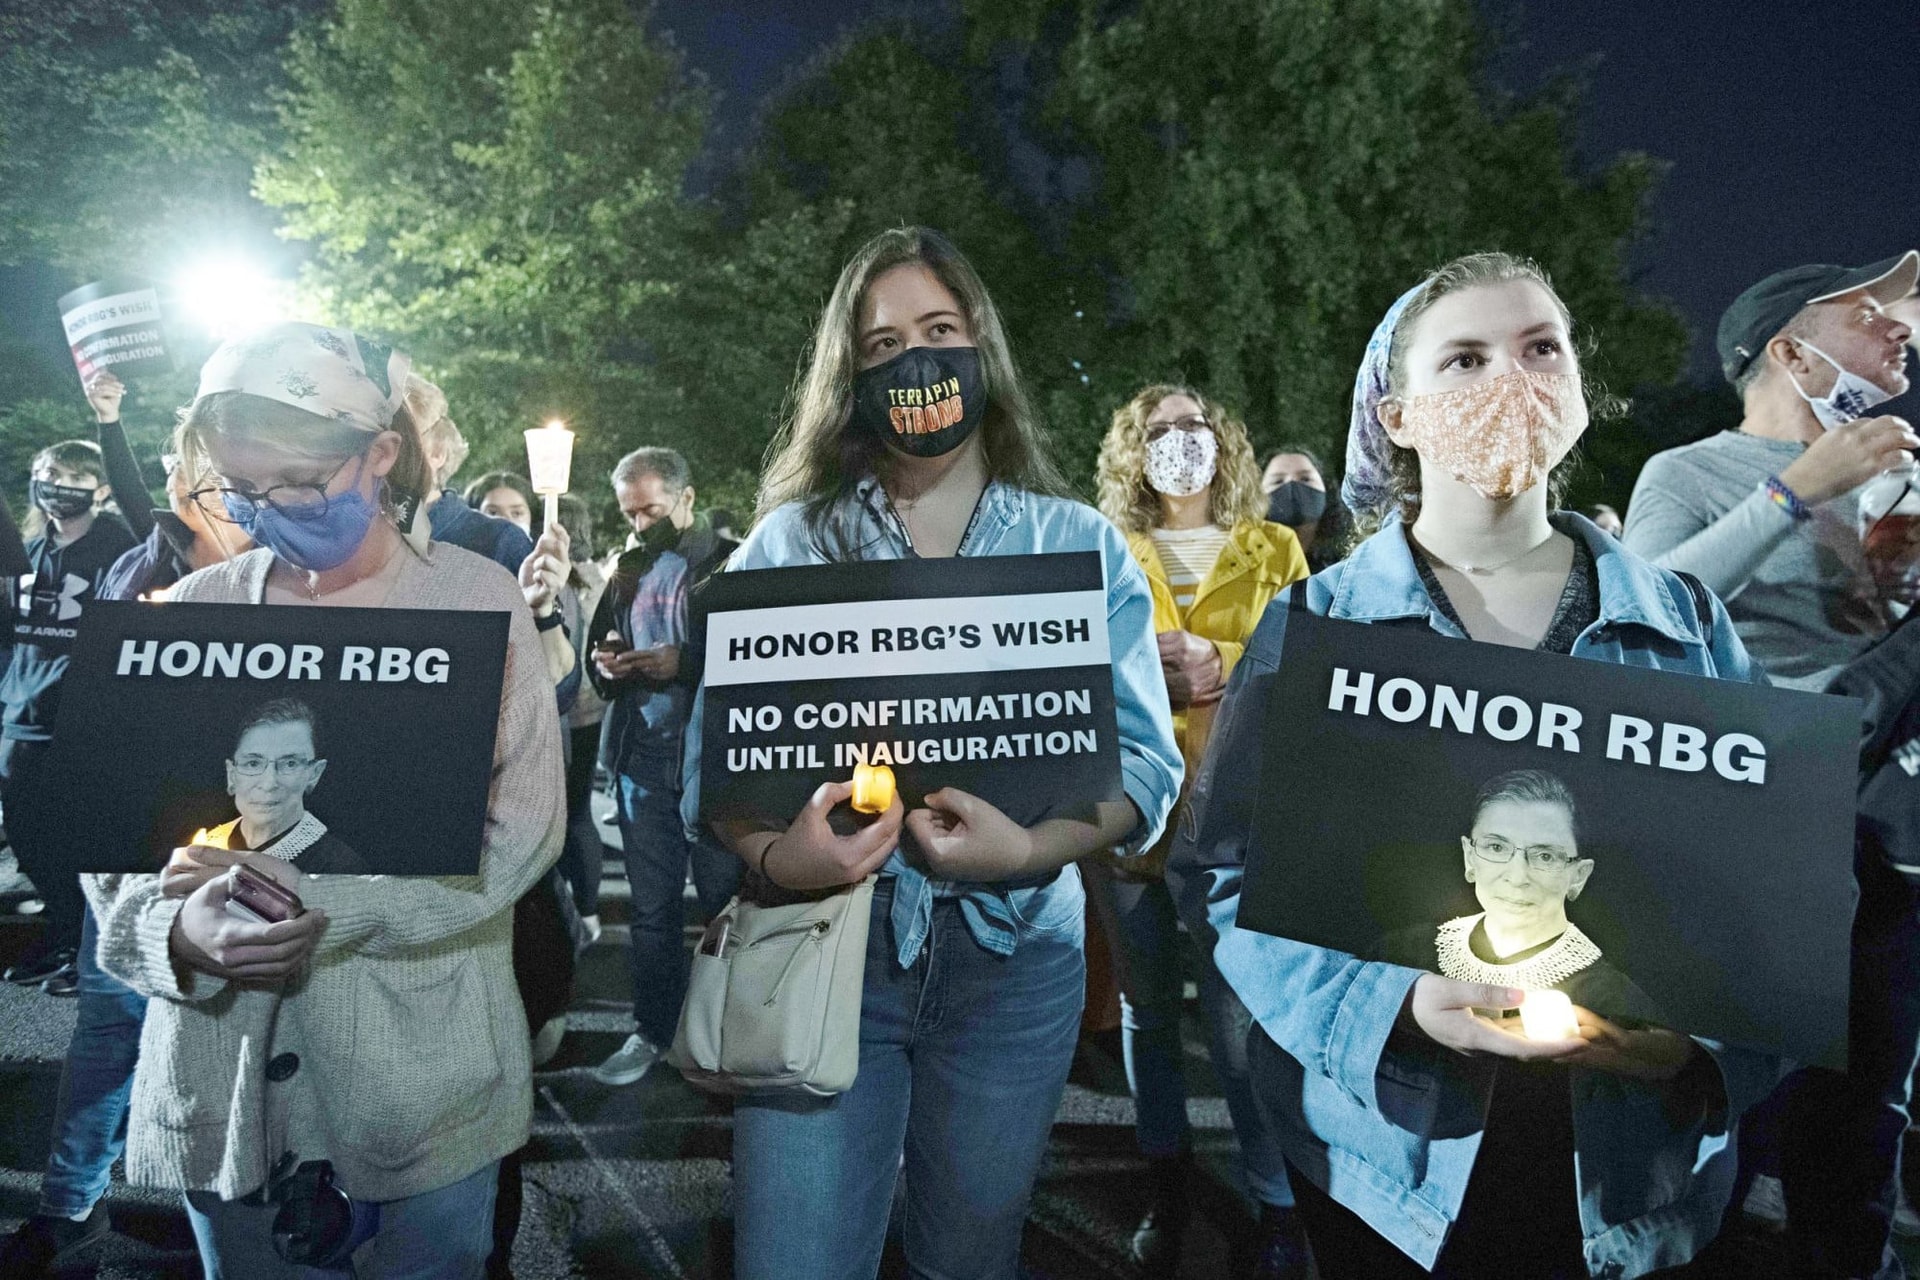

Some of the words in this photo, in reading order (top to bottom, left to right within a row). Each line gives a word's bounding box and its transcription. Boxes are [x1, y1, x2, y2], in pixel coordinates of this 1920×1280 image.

[888, 377, 960, 406] TERRAPIN
[889, 394, 964, 434] STRONG
[117, 640, 324, 680] HONOR
[340, 646, 450, 684] RBG
[728, 630, 860, 662] HONOR
[872, 625, 982, 653] RBG'S
[993, 619, 1090, 647] WISH
[729, 706, 783, 734] NO
[793, 690, 1092, 729] CONFIRMATION
[1327, 667, 1583, 753] HONOR
[1606, 713, 1767, 785] RBG
[728, 744, 825, 772] UNTIL
[834, 730, 1098, 768] INAUGURATION
